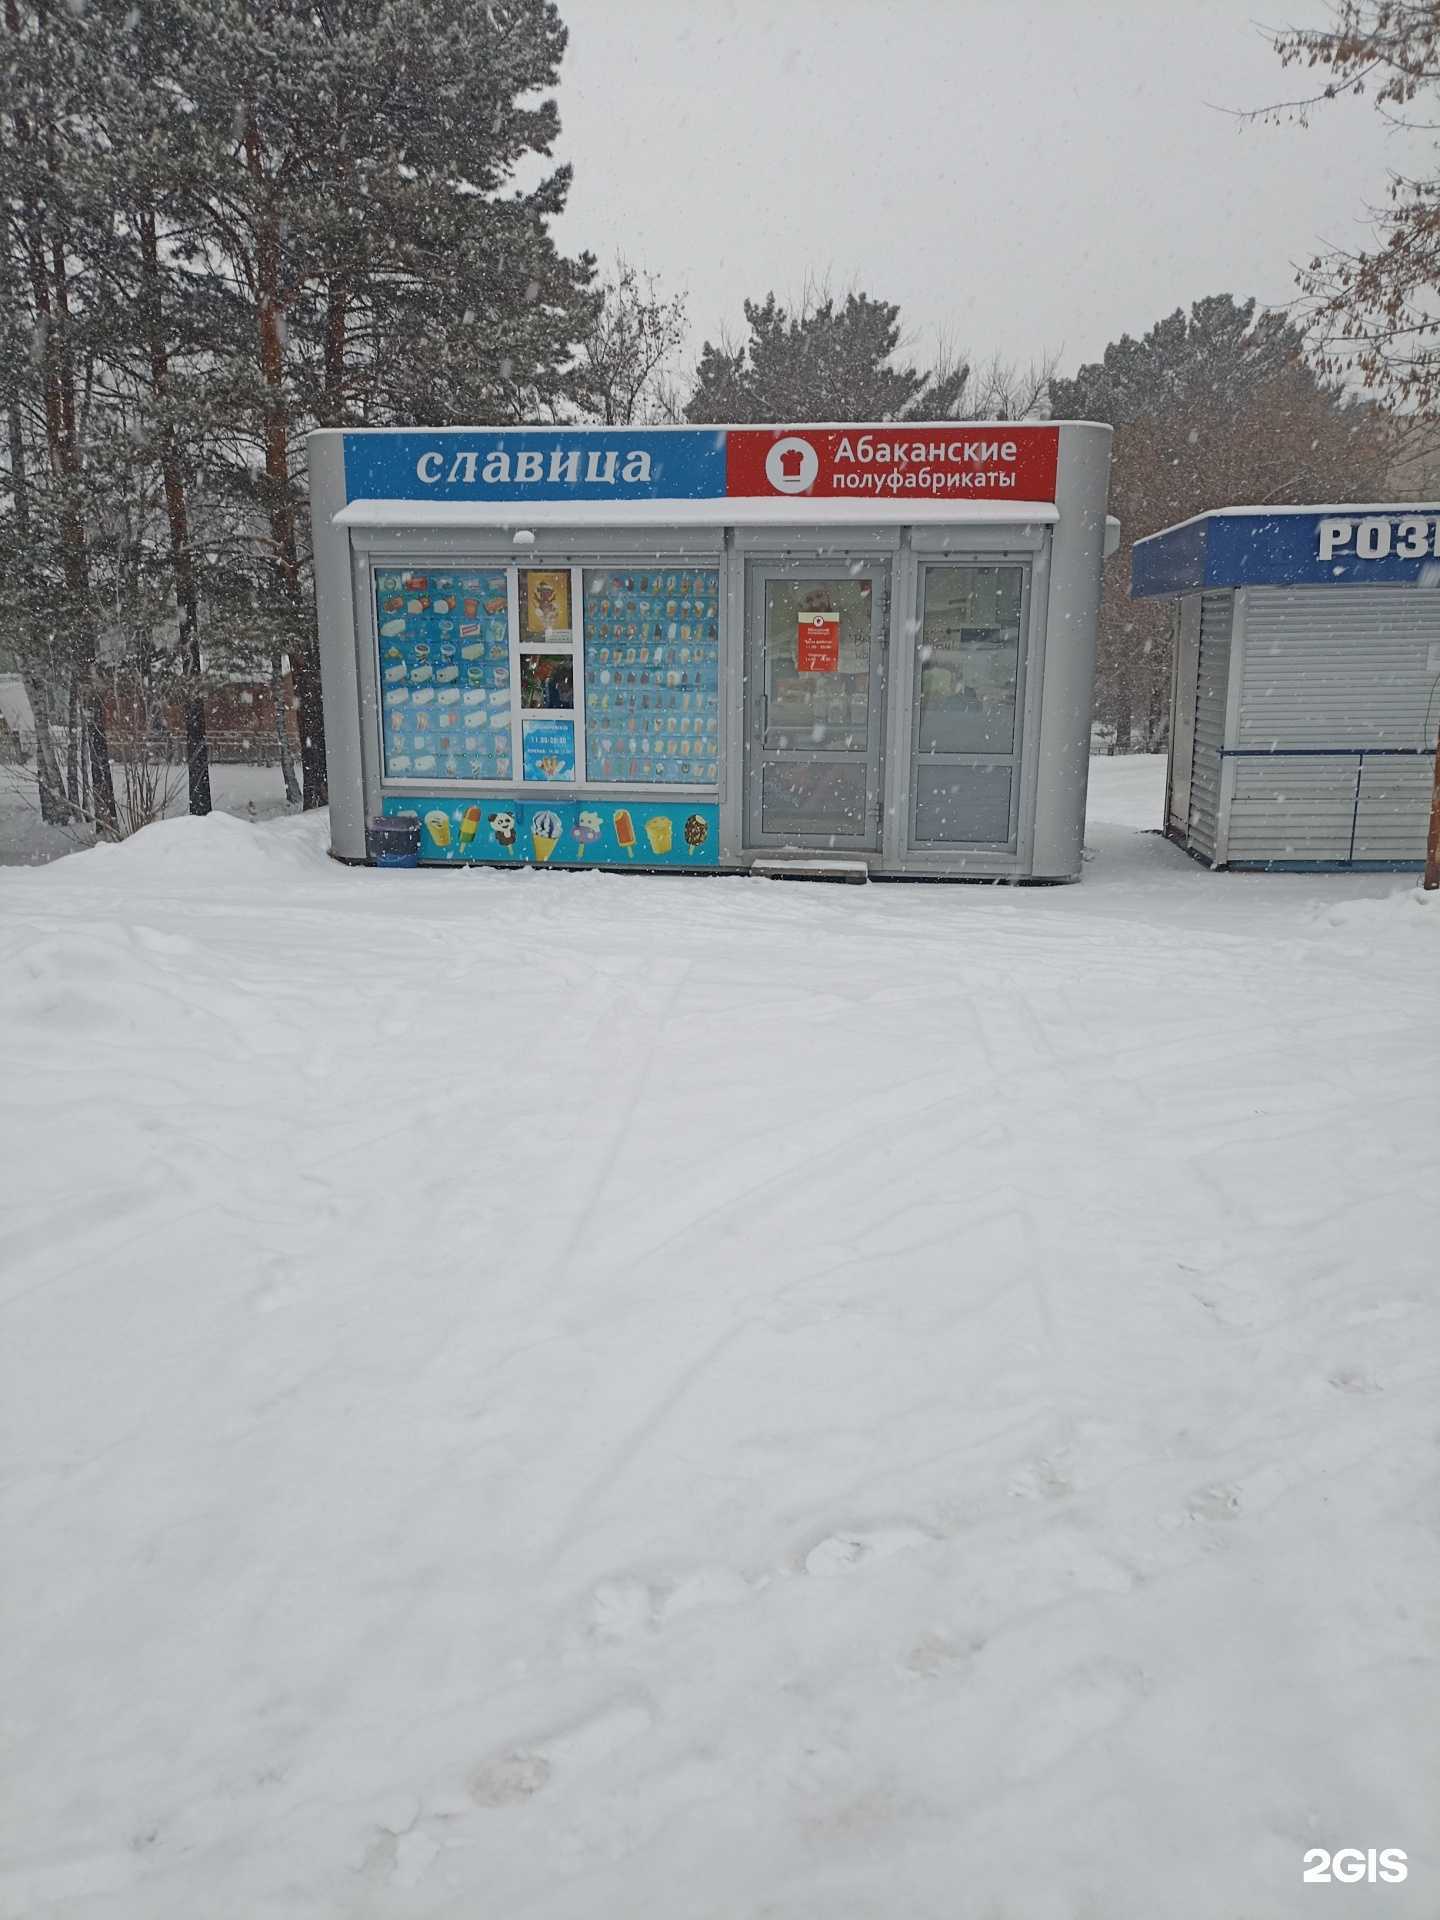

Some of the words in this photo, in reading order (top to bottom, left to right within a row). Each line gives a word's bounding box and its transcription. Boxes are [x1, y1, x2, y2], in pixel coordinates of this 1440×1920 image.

[833, 435, 1018, 463] Абаканские
[416, 449, 653, 485] славица
[832, 467, 1016, 493] полуфабрикаты
[1318, 518, 1440, 560] РОЗ
